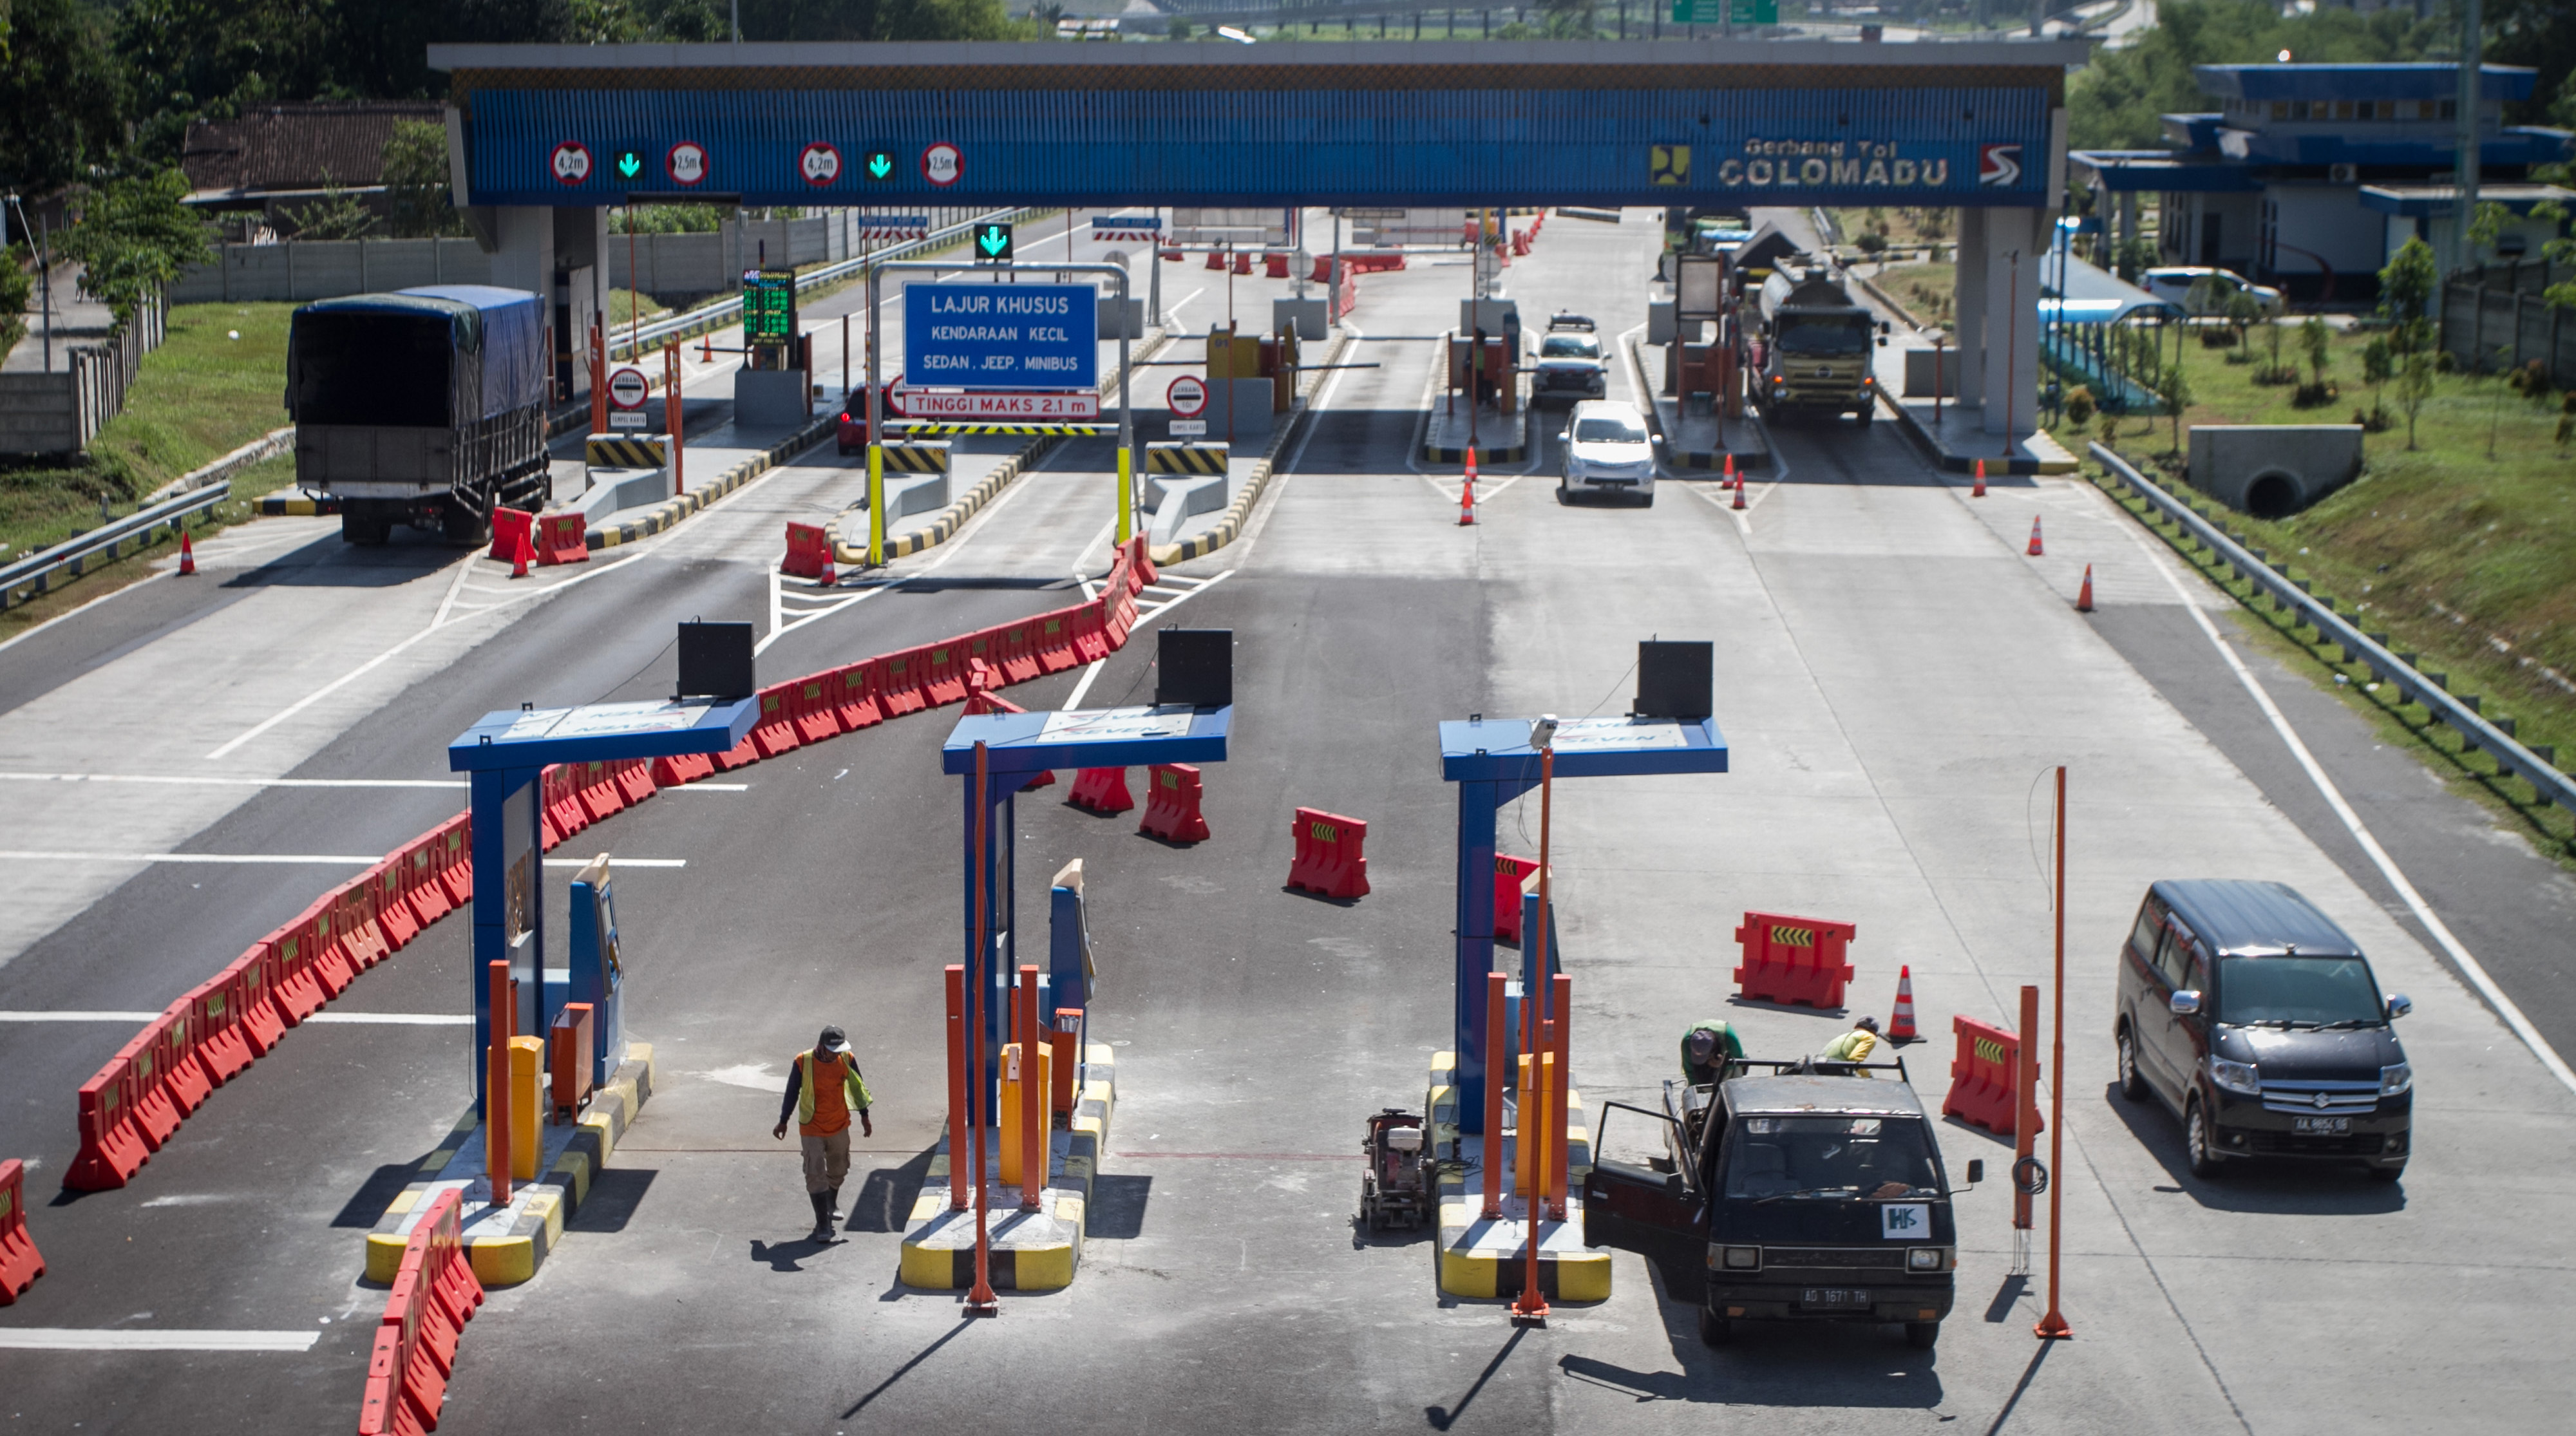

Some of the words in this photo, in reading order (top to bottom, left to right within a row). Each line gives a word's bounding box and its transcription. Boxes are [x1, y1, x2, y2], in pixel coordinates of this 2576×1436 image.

[1745, 138, 1844, 158] Gerbang
[1857, 140, 1897, 158] Tol
[559, 156, 583, 171] 4,2m
[678, 156, 697, 170] 2,5m
[808, 157, 833, 171] 4,2m
[933, 157, 952, 170] 2,5m
[1719, 158, 1948, 187] COLOMADU
[931, 296, 990, 313] LAJUR
[996, 296, 1069, 314] KHUSUS
[932, 326, 1018, 340] KENDARAAN
[1029, 327, 1069, 341] KECIL
[1025, 357, 1078, 370] MINIBUS
[916, 398, 972, 411] TINGGI
[980, 398, 1033, 411] MAKS
[1072, 402, 1086, 412] m
[1804, 1290, 1817, 1301] AD
[1824, 1290, 1848, 1302] 1671
[1853, 1290, 1867, 1302] TH
